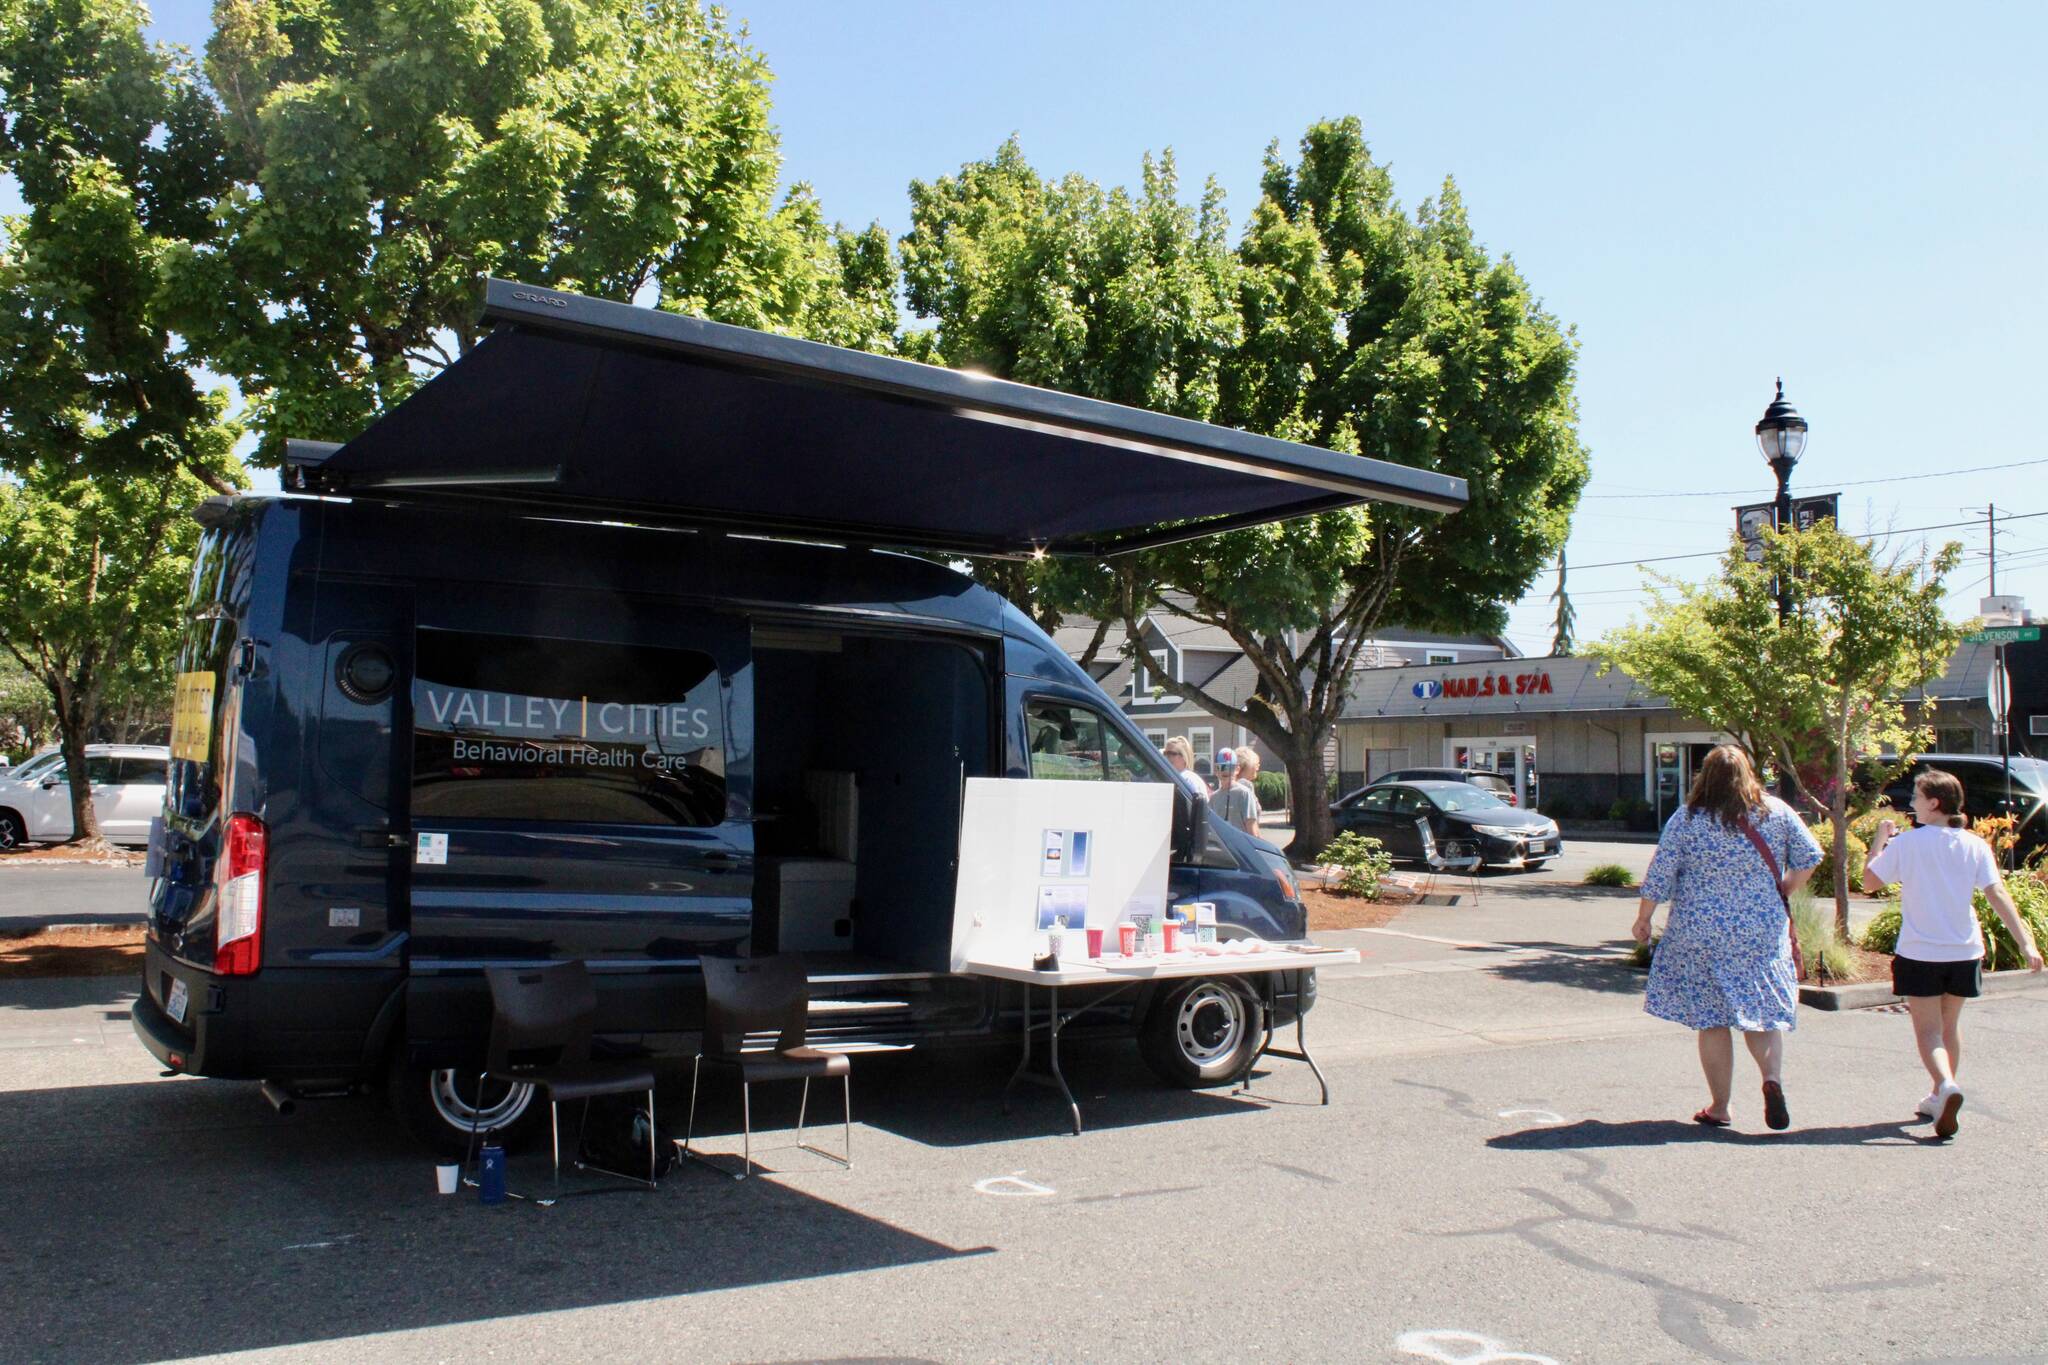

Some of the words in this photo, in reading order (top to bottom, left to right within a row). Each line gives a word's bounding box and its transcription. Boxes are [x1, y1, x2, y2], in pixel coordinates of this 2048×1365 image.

[1418, 681, 1434, 699] T
[1442, 675, 1496, 698] NAILS
[1498, 674, 1512, 695] &
[1516, 672, 1553, 695] SPA
[427, 690, 570, 730] VALLEY
[600, 702, 709, 738] CITIES
[453, 739, 563, 763] Behavioral
[570, 746, 634, 768] Health
[641, 750, 687, 769] Care
